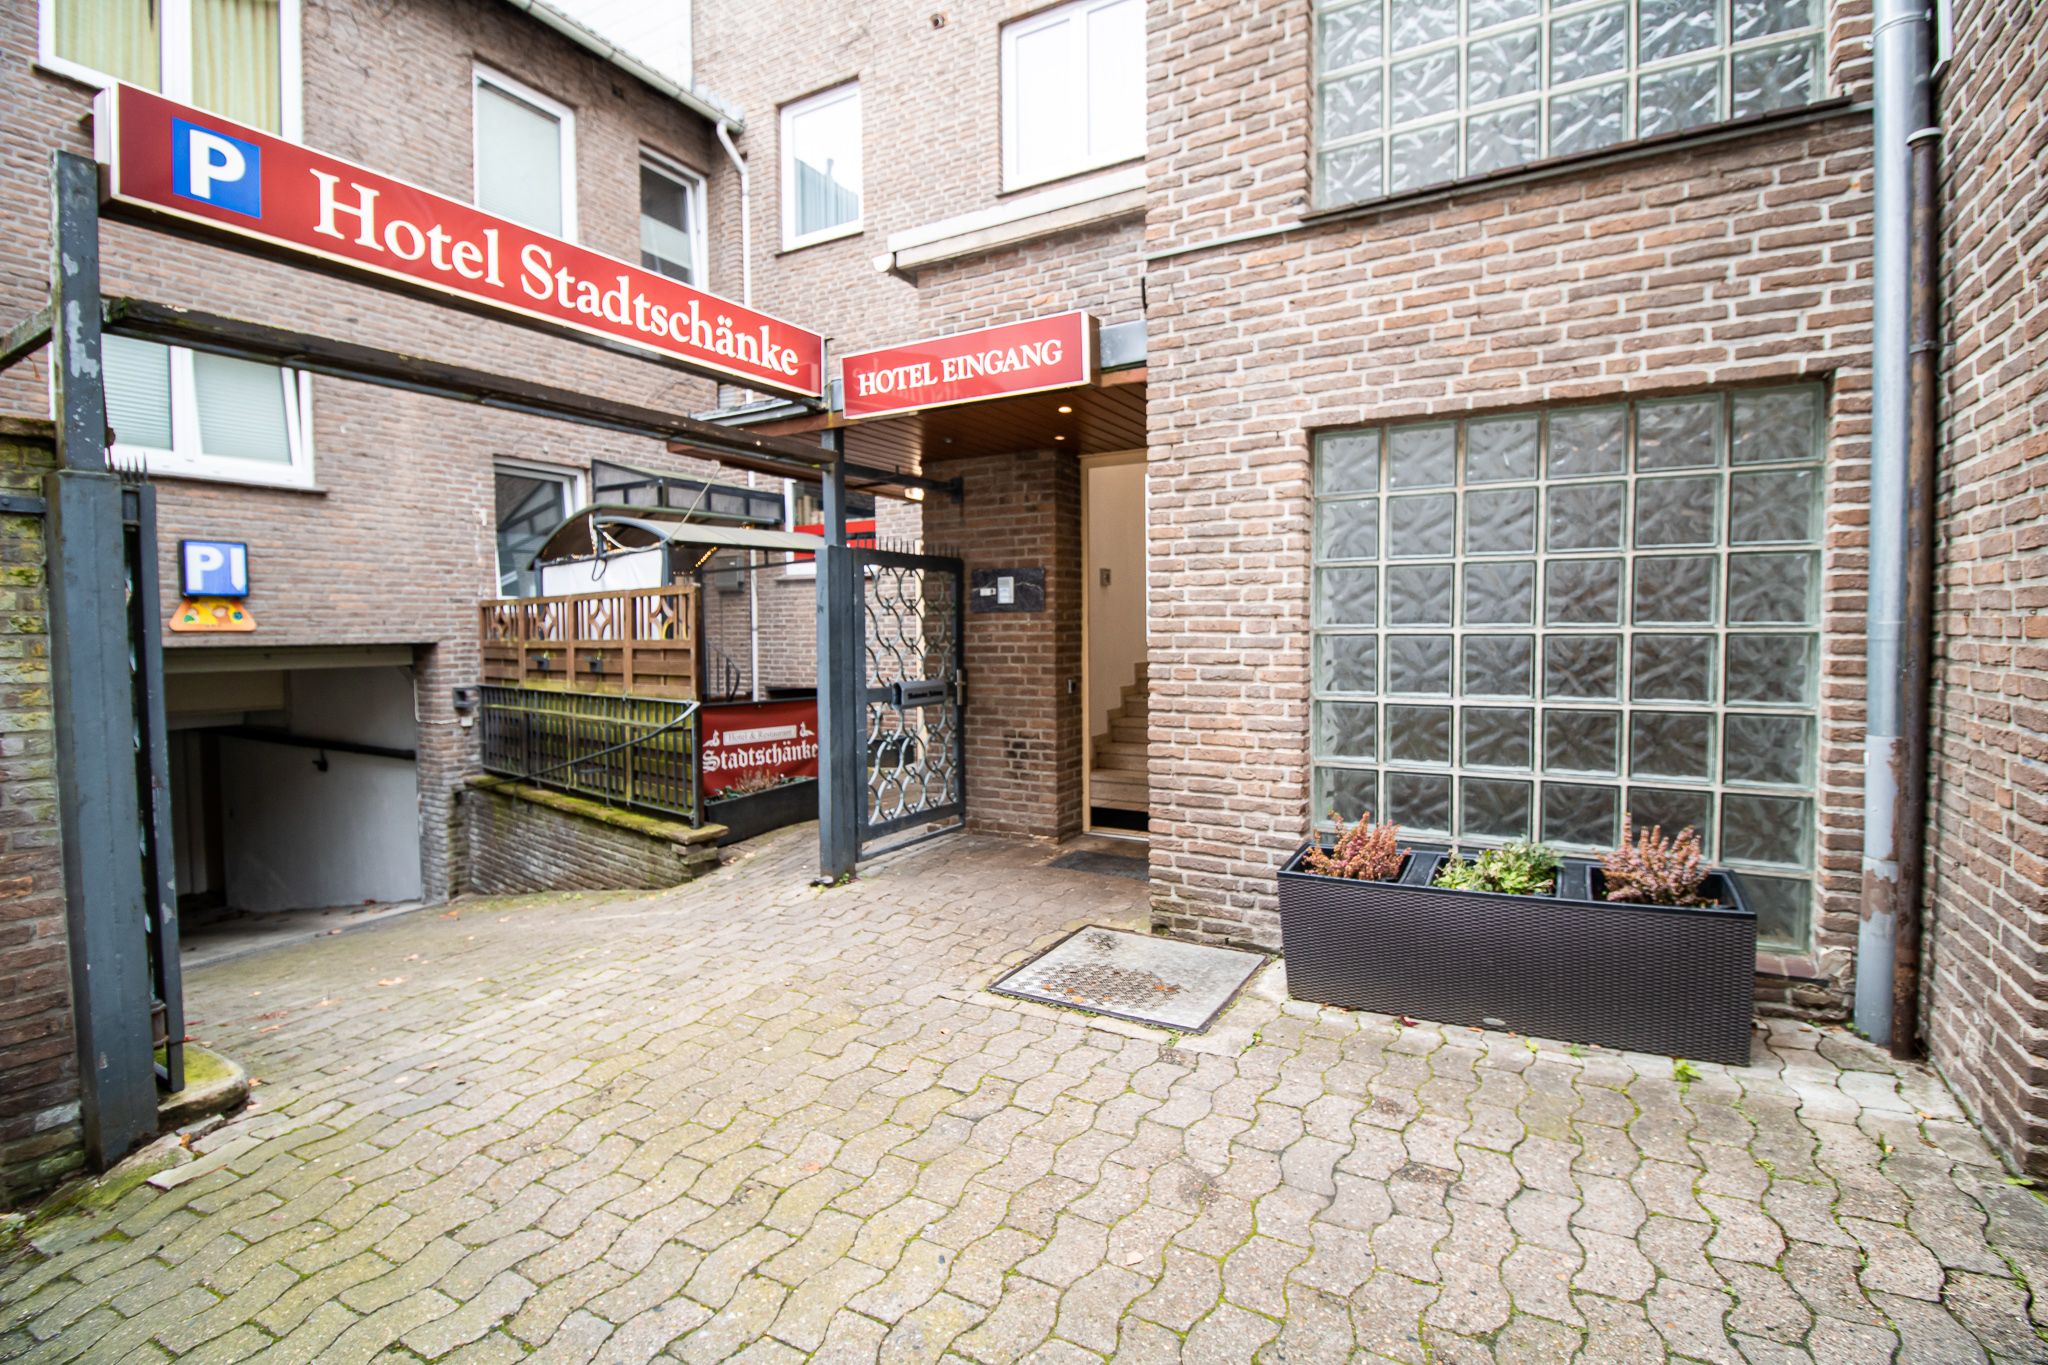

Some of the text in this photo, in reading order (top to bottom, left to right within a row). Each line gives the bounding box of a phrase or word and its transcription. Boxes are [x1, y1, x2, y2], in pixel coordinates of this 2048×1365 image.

[189, 128, 246, 200] P
[309, 168, 799, 376] Hotel Stadtschänke
[857, 339, 1063, 397] HOTEL EINGANG
[703, 740, 818, 773] Stadtschänke
